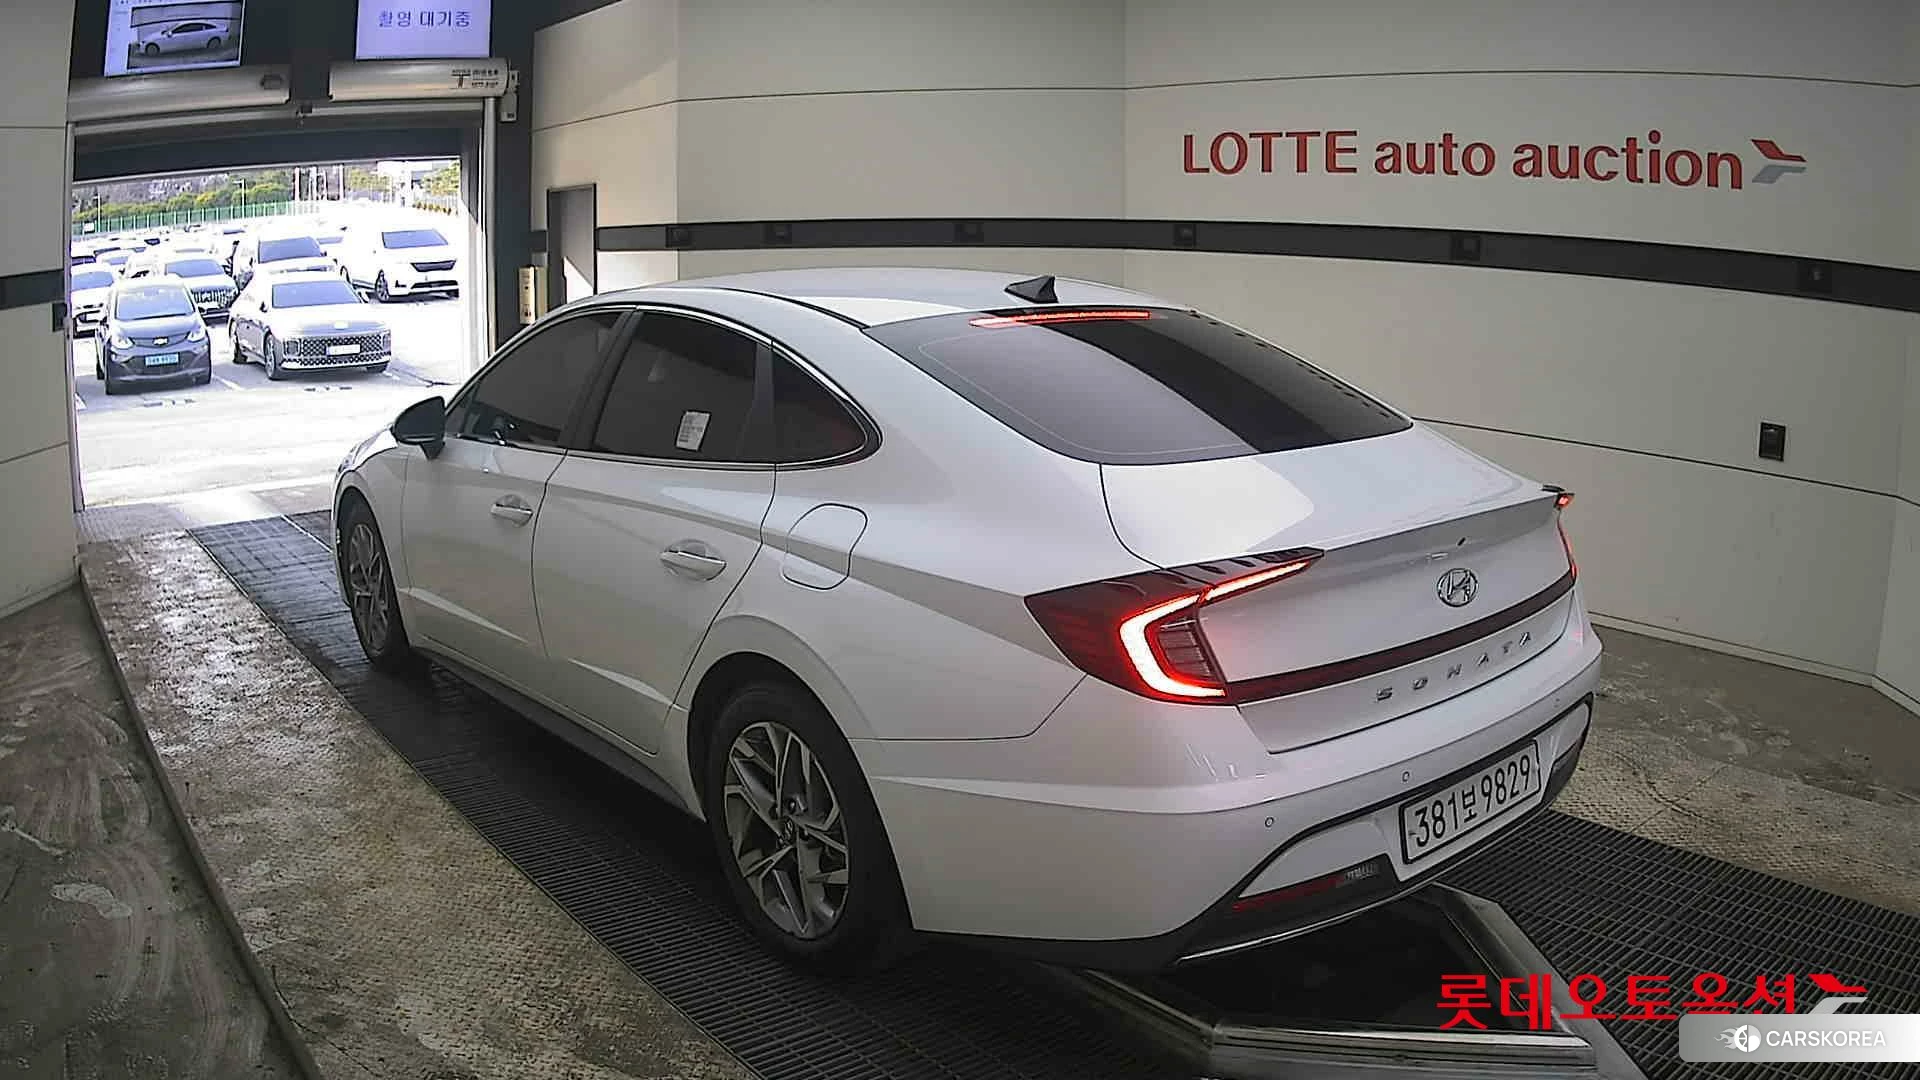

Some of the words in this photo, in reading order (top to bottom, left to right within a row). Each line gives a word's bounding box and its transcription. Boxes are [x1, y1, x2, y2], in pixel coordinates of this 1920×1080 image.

[420, 11, 470, 28] 대기중
[1183, 130, 1358, 174] LOTTE
[1374, 132, 1496, 177] auto
[1512, 129, 1743, 190] auction
[1375, 631, 1532, 702] SONATA
[1413, 754, 1532, 848] 381보9829
